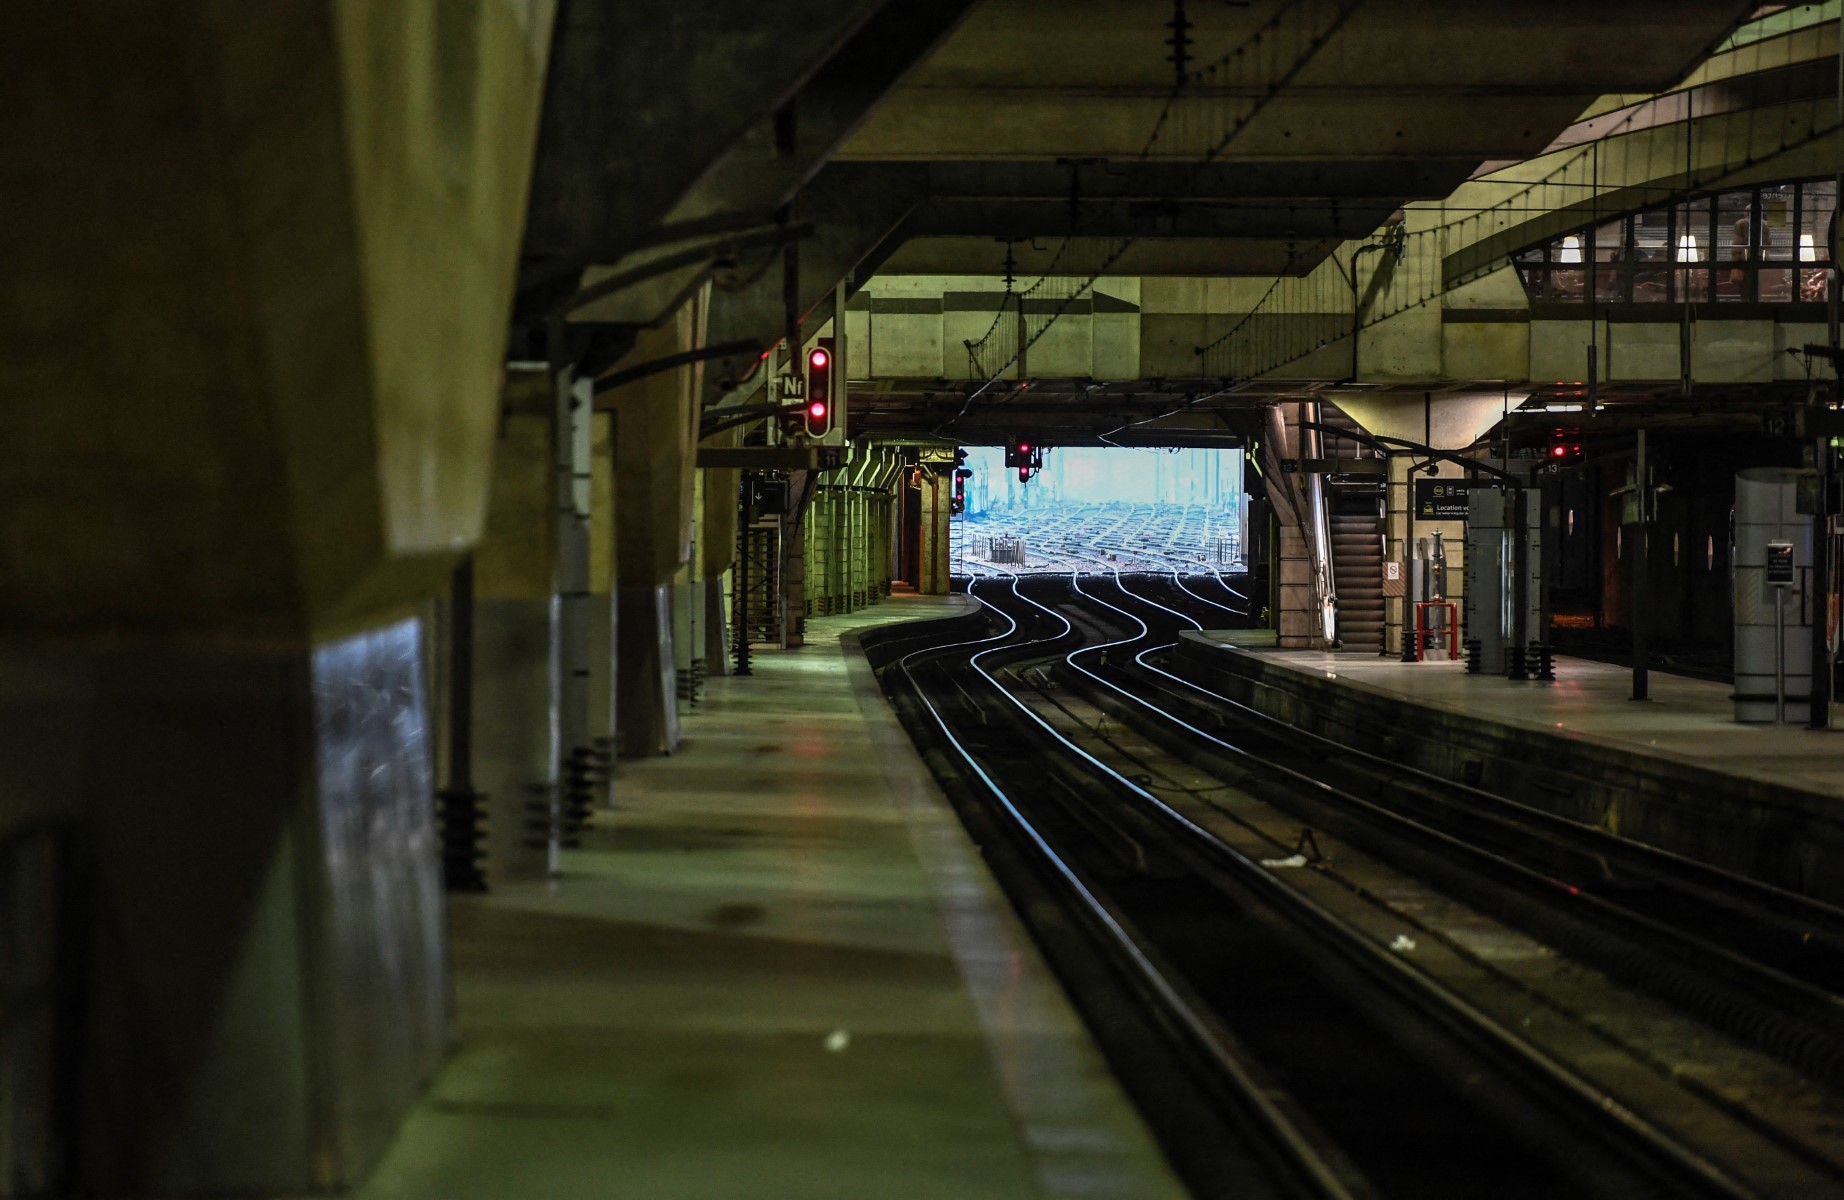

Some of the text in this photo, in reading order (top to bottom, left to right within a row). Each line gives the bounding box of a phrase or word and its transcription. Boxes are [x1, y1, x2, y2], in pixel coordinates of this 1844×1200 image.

[784, 376, 803, 395] Nf
[1767, 418, 1785, 434] 12
[825, 455, 836, 466] 11
[1547, 464, 1558, 473] 13
